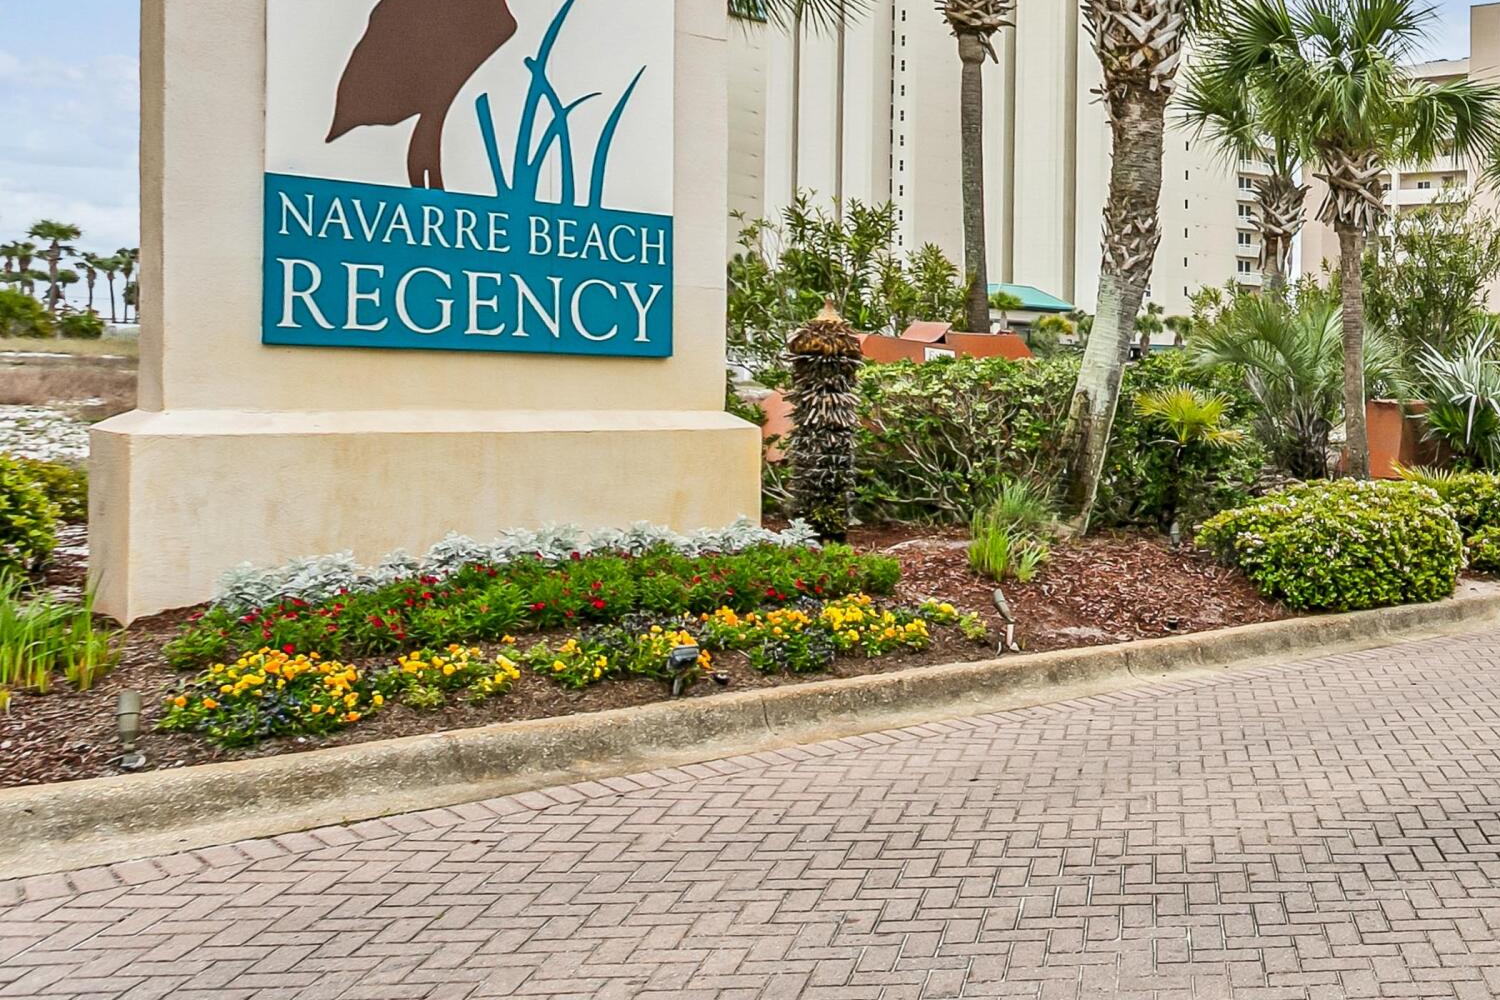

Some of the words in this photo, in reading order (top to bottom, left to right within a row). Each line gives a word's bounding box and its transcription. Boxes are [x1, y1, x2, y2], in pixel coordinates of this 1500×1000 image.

[277, 190, 510, 254] NAVARRE
[527, 214, 668, 265] BEACH
[276, 256, 664, 344] REGENCY
